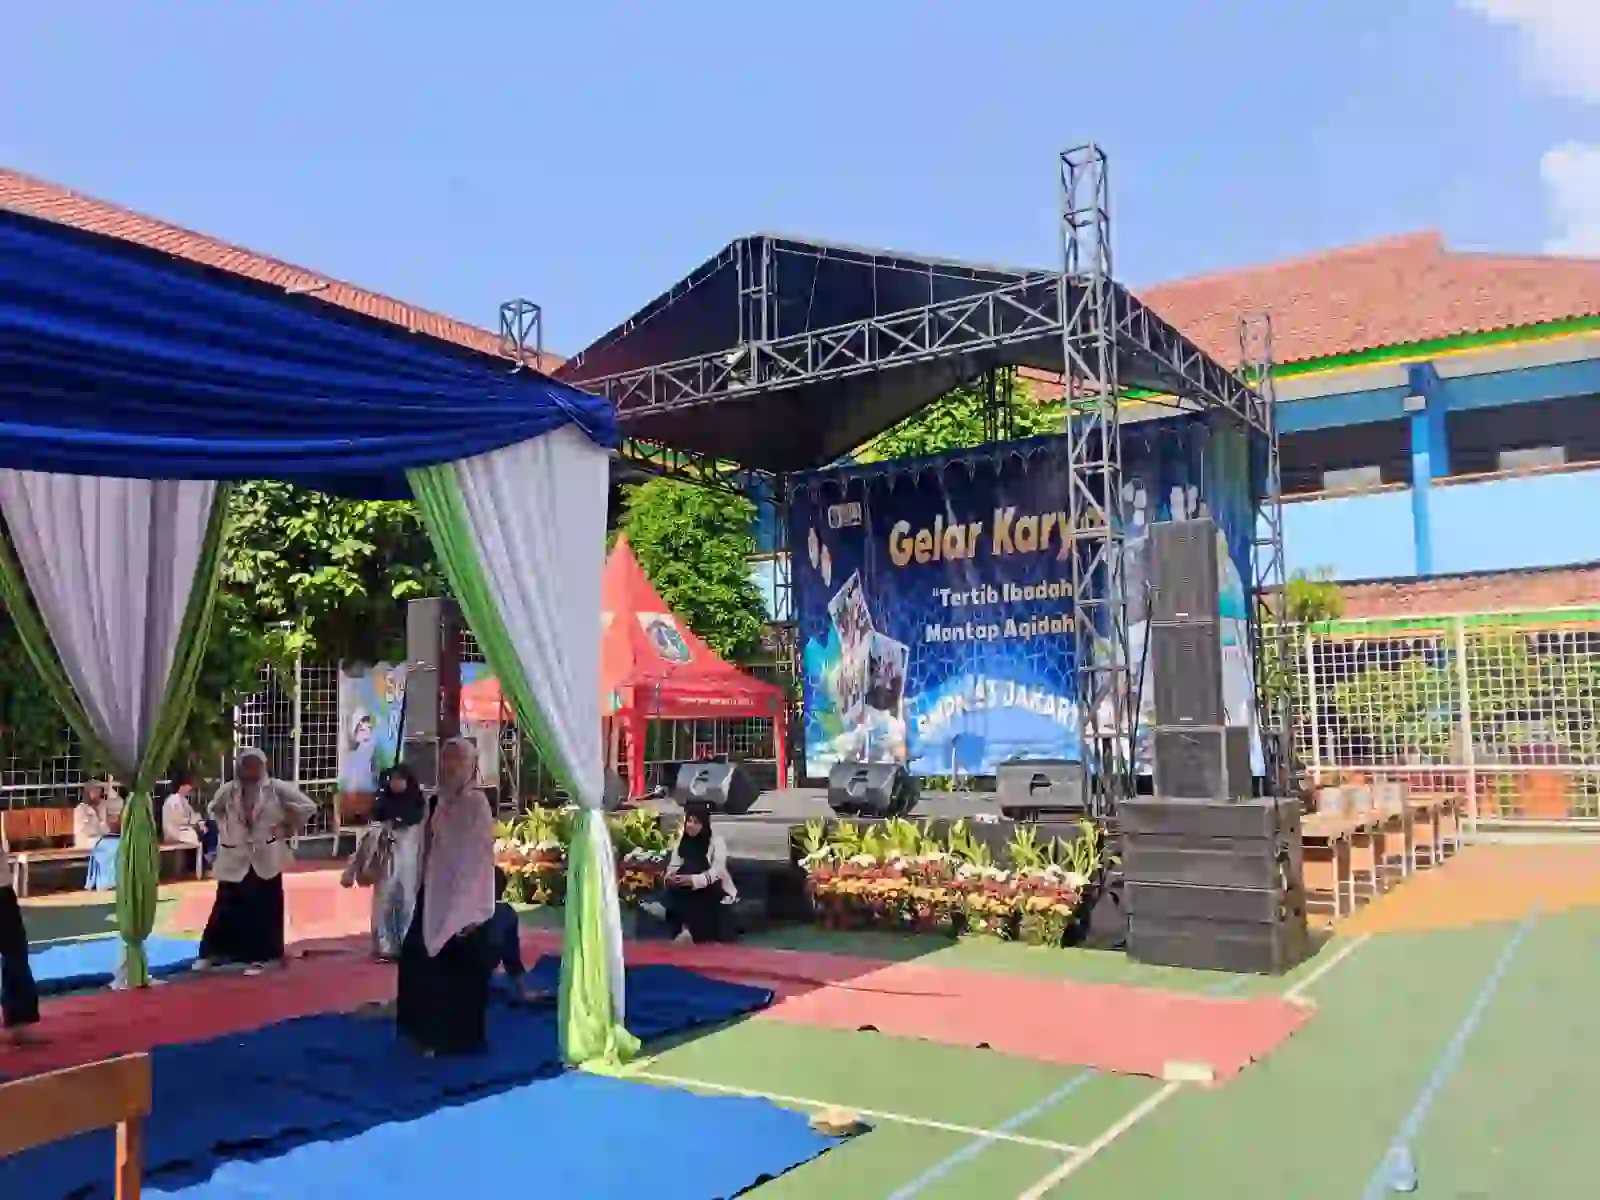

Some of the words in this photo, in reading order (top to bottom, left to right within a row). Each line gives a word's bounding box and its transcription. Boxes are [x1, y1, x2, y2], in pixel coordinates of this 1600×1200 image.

[889, 514, 983, 567] Gelar
[1003, 578, 1074, 603] Ibadah
[925, 621, 999, 643] Mantap
